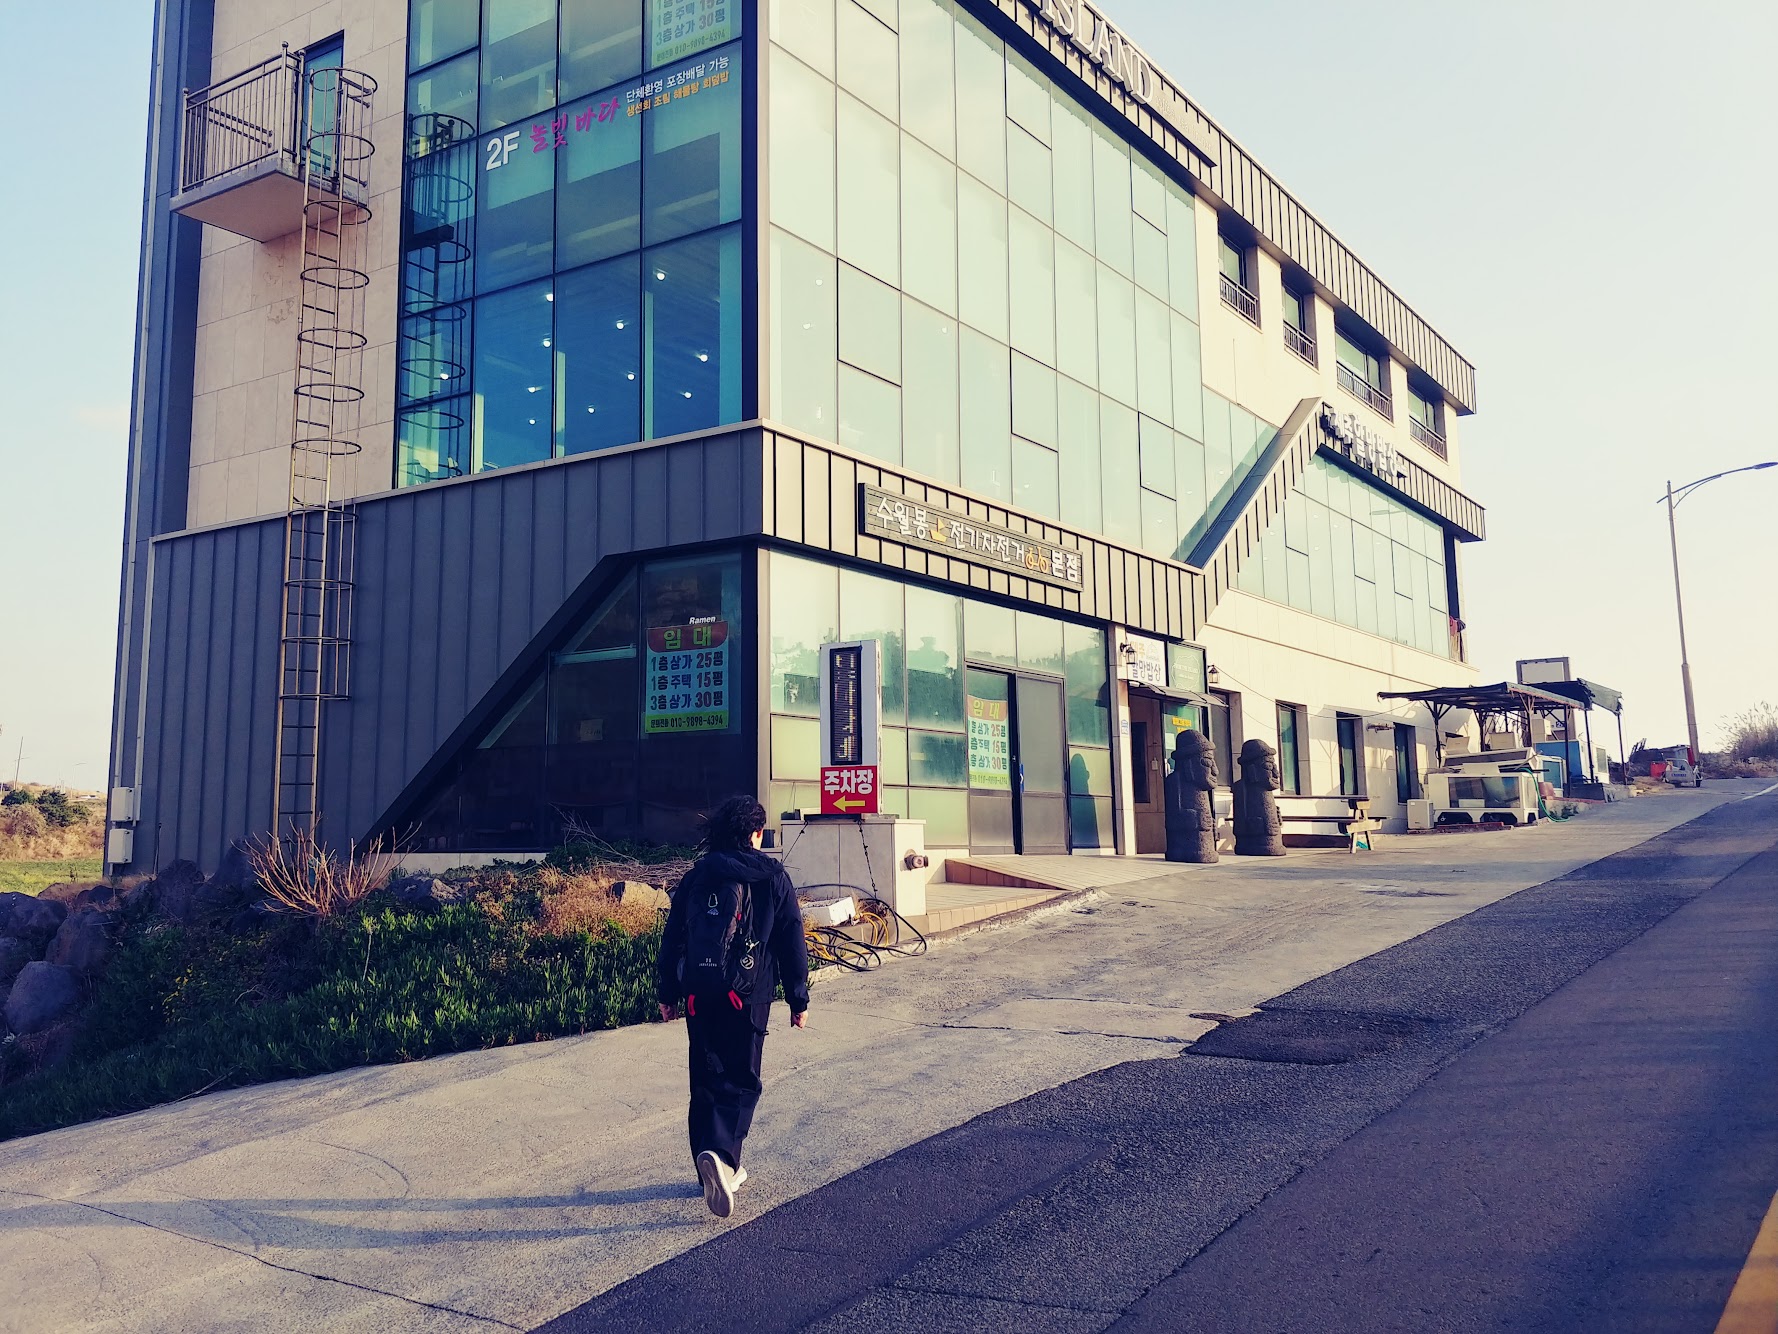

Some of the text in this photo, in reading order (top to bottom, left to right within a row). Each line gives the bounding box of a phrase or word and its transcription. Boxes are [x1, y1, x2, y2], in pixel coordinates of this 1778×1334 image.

[656, 8, 725, 46] 3층 상가 30평
[626, 56, 730, 103] 단체환영 포장배달 가능
[575, 96, 620, 132] 바다
[486, 130, 521, 170] 2F
[876, 497, 1079, 582] 수월봉 전기자전거 본점
[689, 616, 716, 625] Ramen
[651, 650, 724, 672] 1층 상가 25평
[651, 670, 724, 691] 1층 주택 15평
[650, 690, 724, 711] 3층 상가 30평
[670, 714, 723, 728] 010-9898-4394
[824, 769, 874, 795] 주차장
